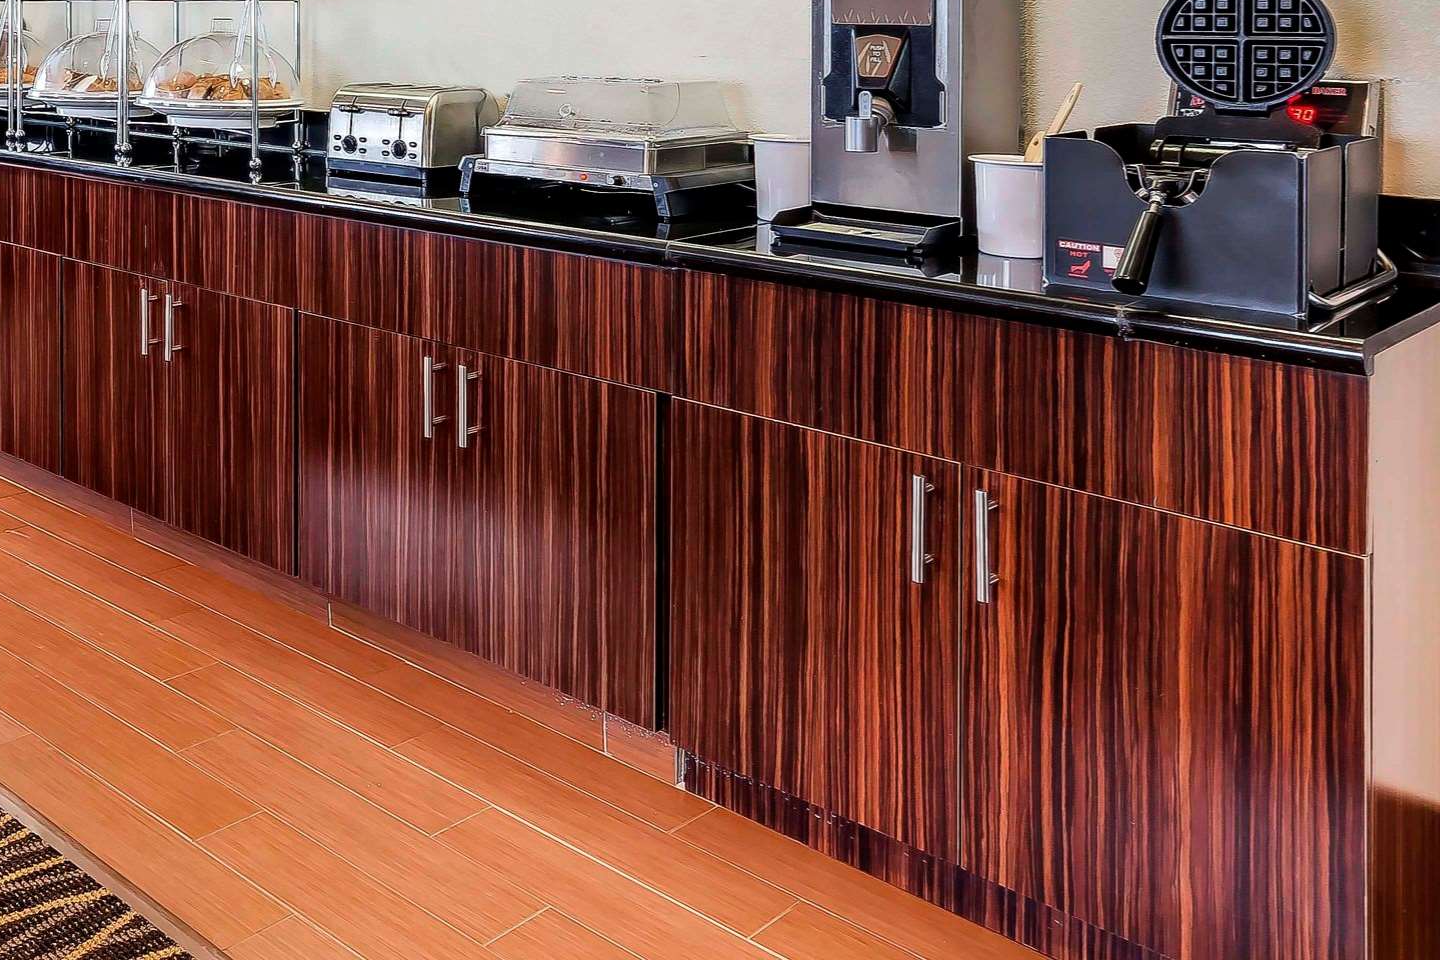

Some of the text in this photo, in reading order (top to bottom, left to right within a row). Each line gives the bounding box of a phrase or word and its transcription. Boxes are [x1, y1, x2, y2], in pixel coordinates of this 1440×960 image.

[1312, 86, 1348, 96] BAKER
[1058, 240, 1101, 252] CAUTION
[1069, 250, 1089, 258] HOT
